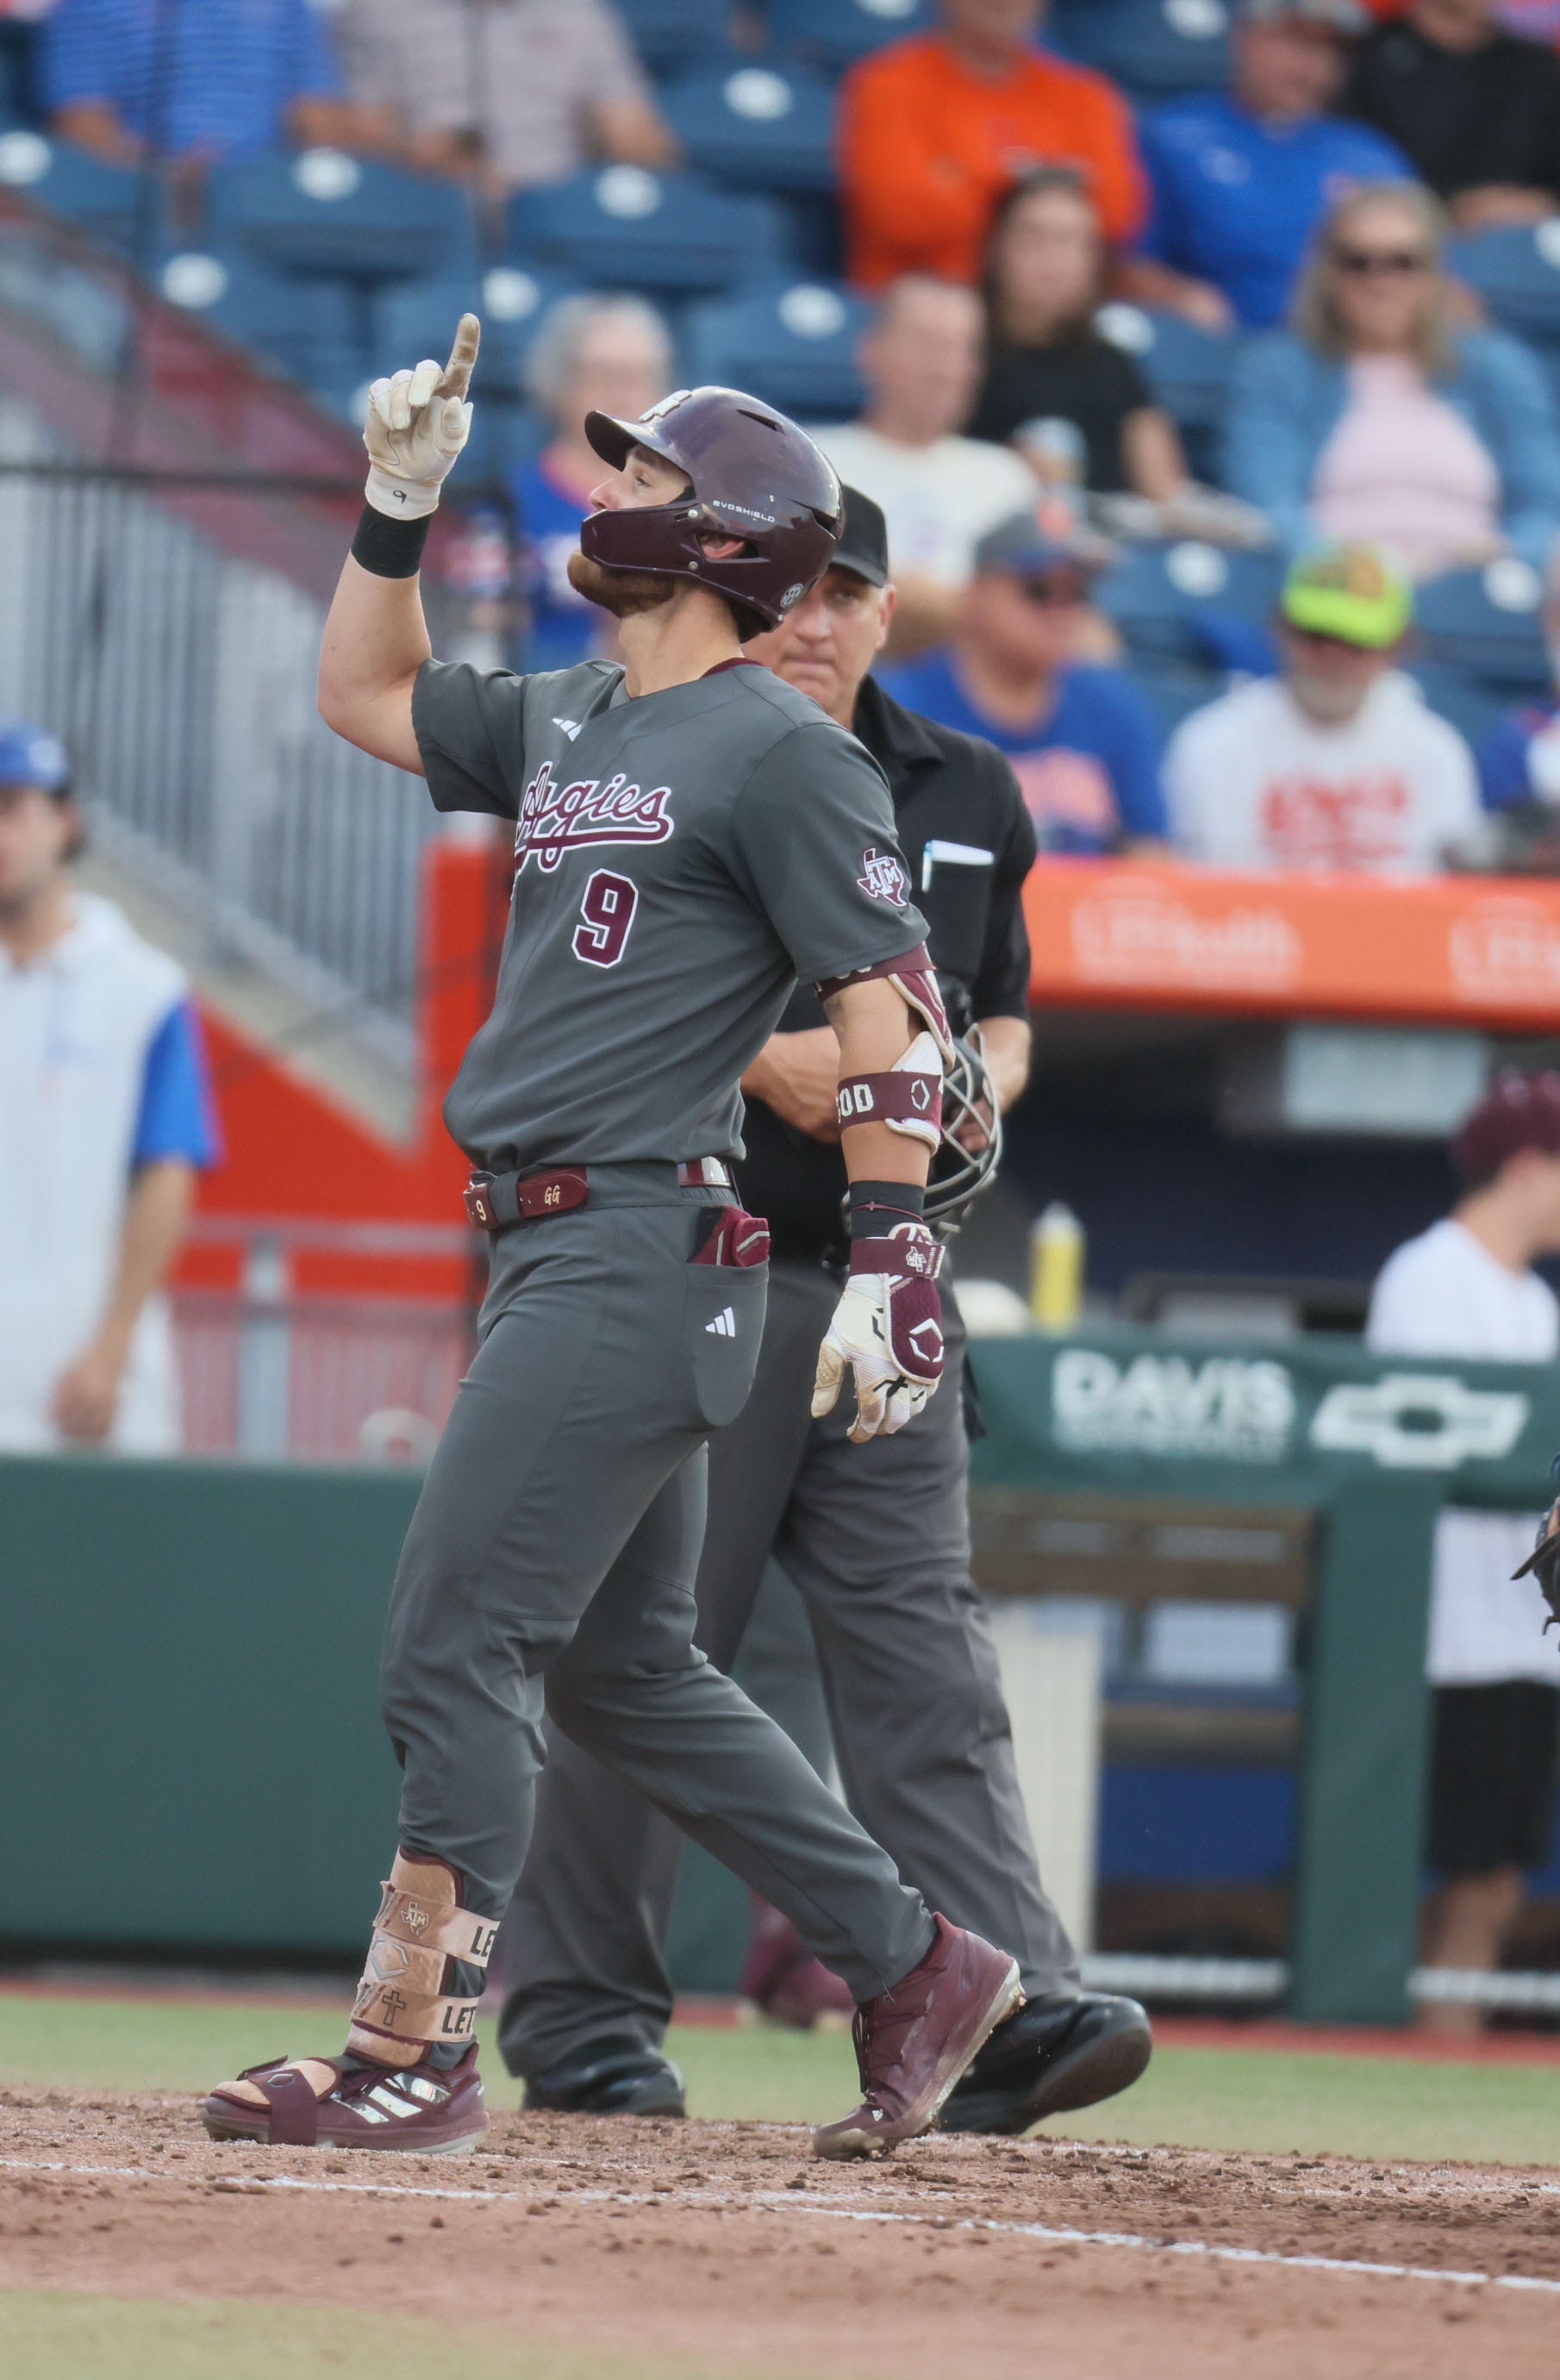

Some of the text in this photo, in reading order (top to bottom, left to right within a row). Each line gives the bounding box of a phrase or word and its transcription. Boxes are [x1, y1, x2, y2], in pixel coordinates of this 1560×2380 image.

[713, 500, 776, 523] EVOSHIELD
[571, 867, 639, 969] 9
[476, 1199, 487, 1221] 9
[1052, 1349, 1295, 1429] DAVIS
